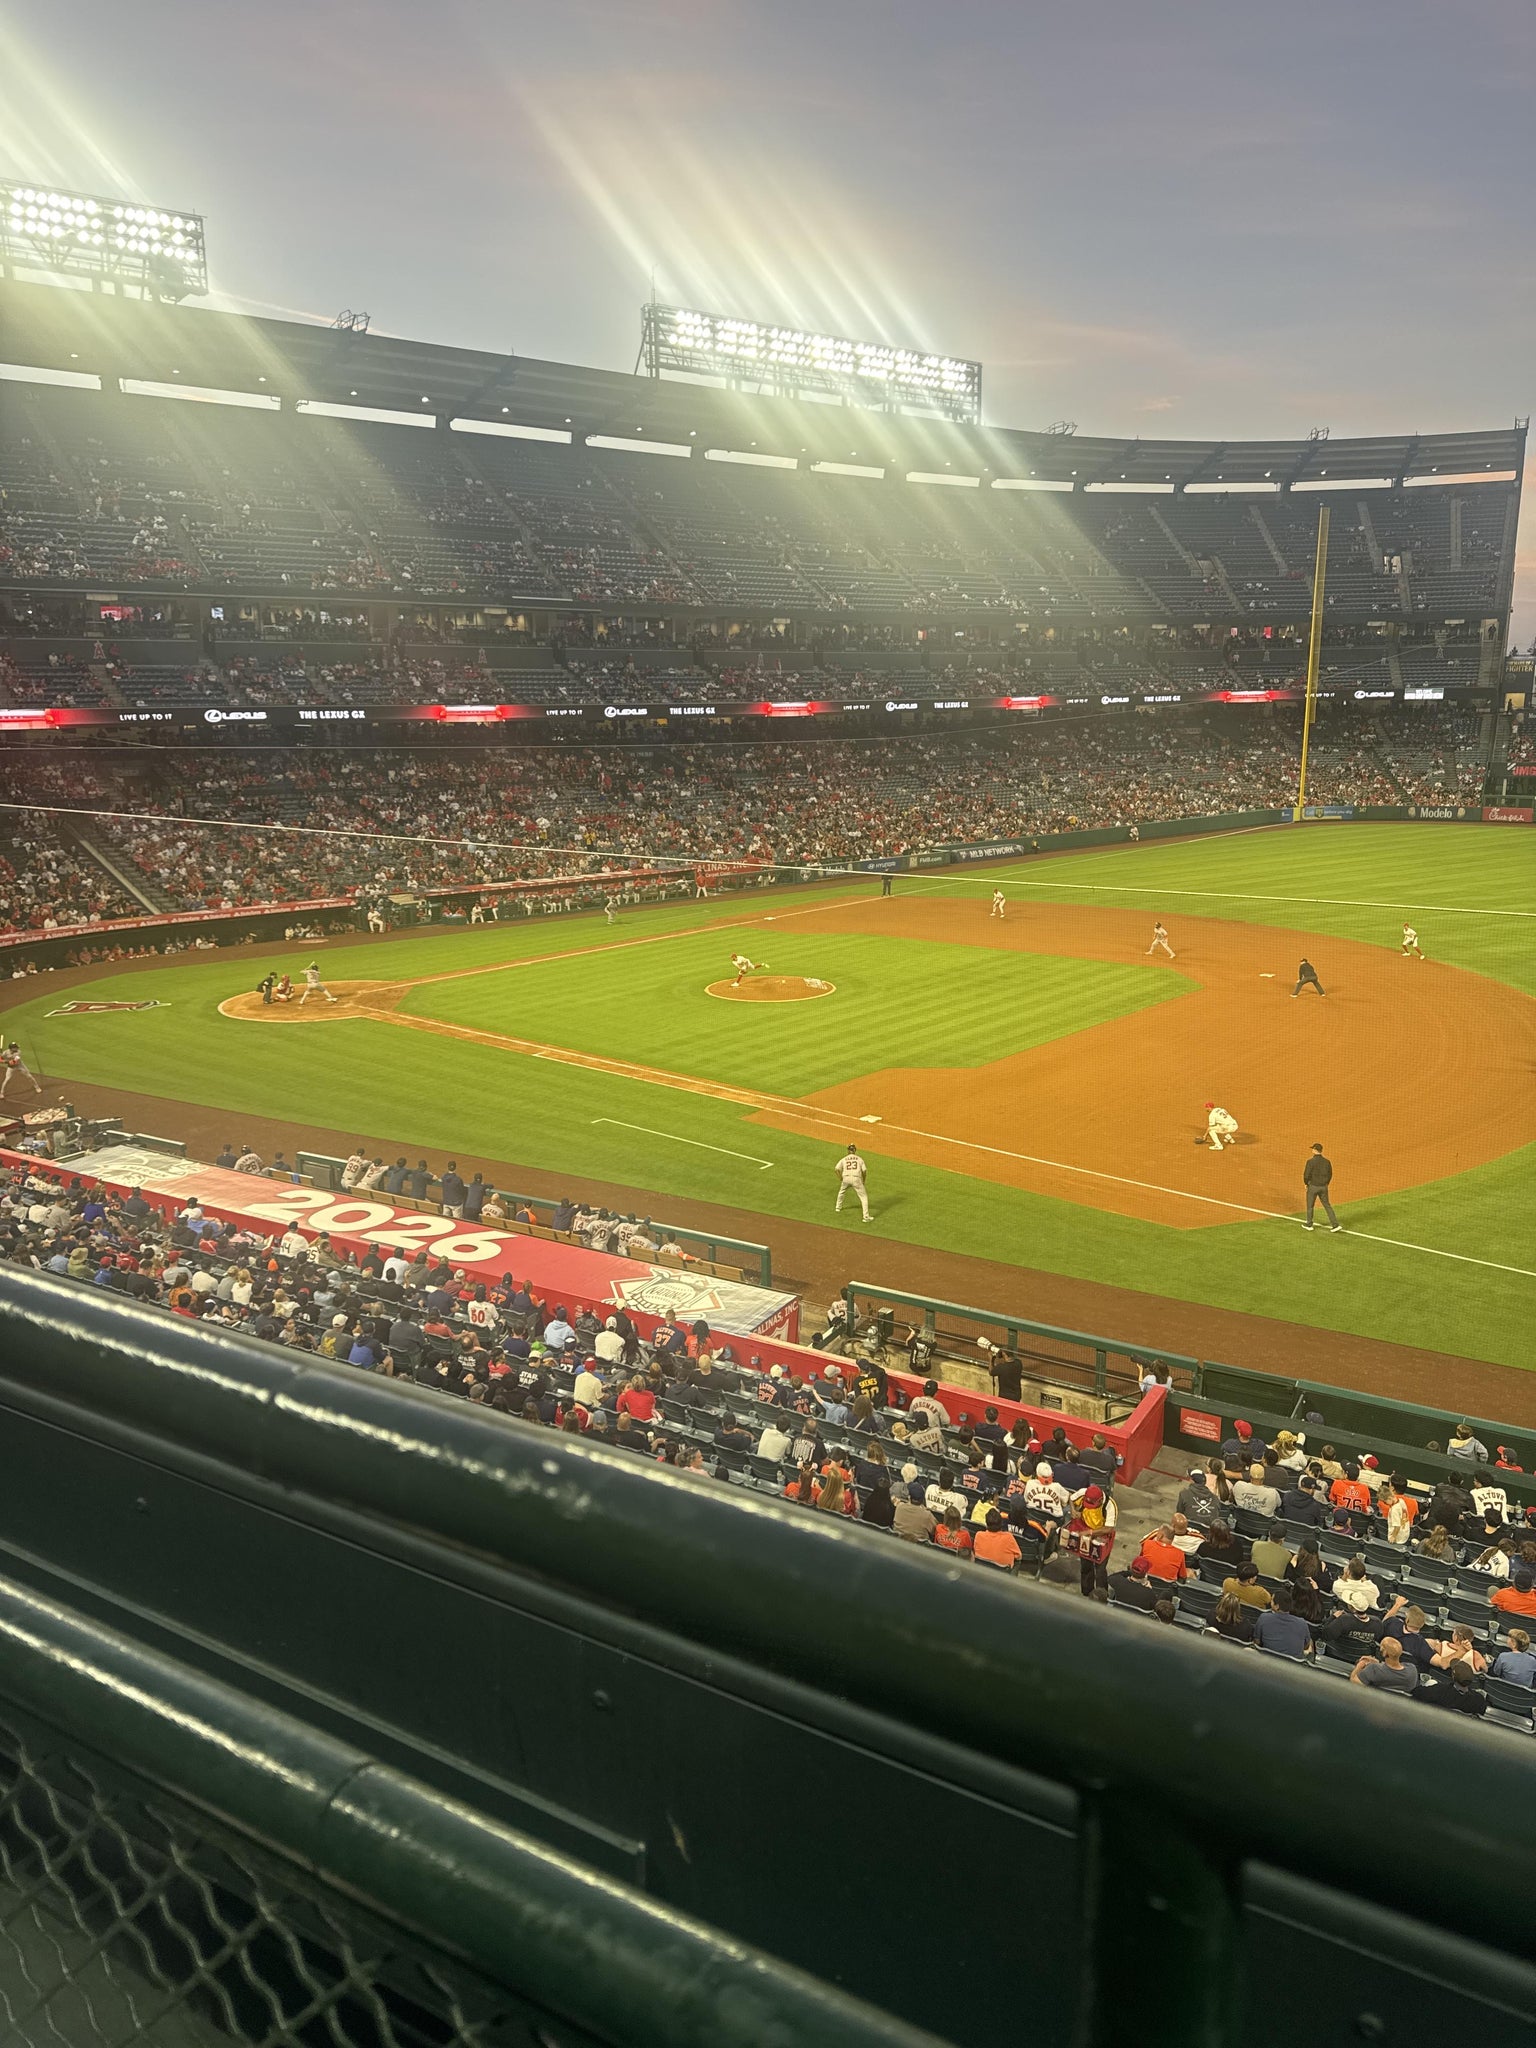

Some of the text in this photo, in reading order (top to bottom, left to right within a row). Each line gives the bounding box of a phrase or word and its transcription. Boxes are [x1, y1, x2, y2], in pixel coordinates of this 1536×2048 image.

[152, 713, 163, 721] TO
[299, 710, 366, 720] THE LEXUS GX
[669, 707, 683, 715] THE
[683, 707, 705, 715] LEXUS
[1420, 807, 1453, 819] Modelo
[969, 846, 1016, 859] MLB NETWORK
[846, 1160, 858, 1171] 23
[241, 1189, 518, 1262] 2026
[784, 1300, 799, 1317] INC.
[656, 1325, 676, 1336] ALTUVE
[654, 1333, 672, 1348] 27
[519, 1370, 539, 1380] STAR
[916, 1432, 939, 1447] ALTUVE
[1477, 1491, 1505, 1503] ALTUVE
[1341, 1496, 1362, 1512] 76
